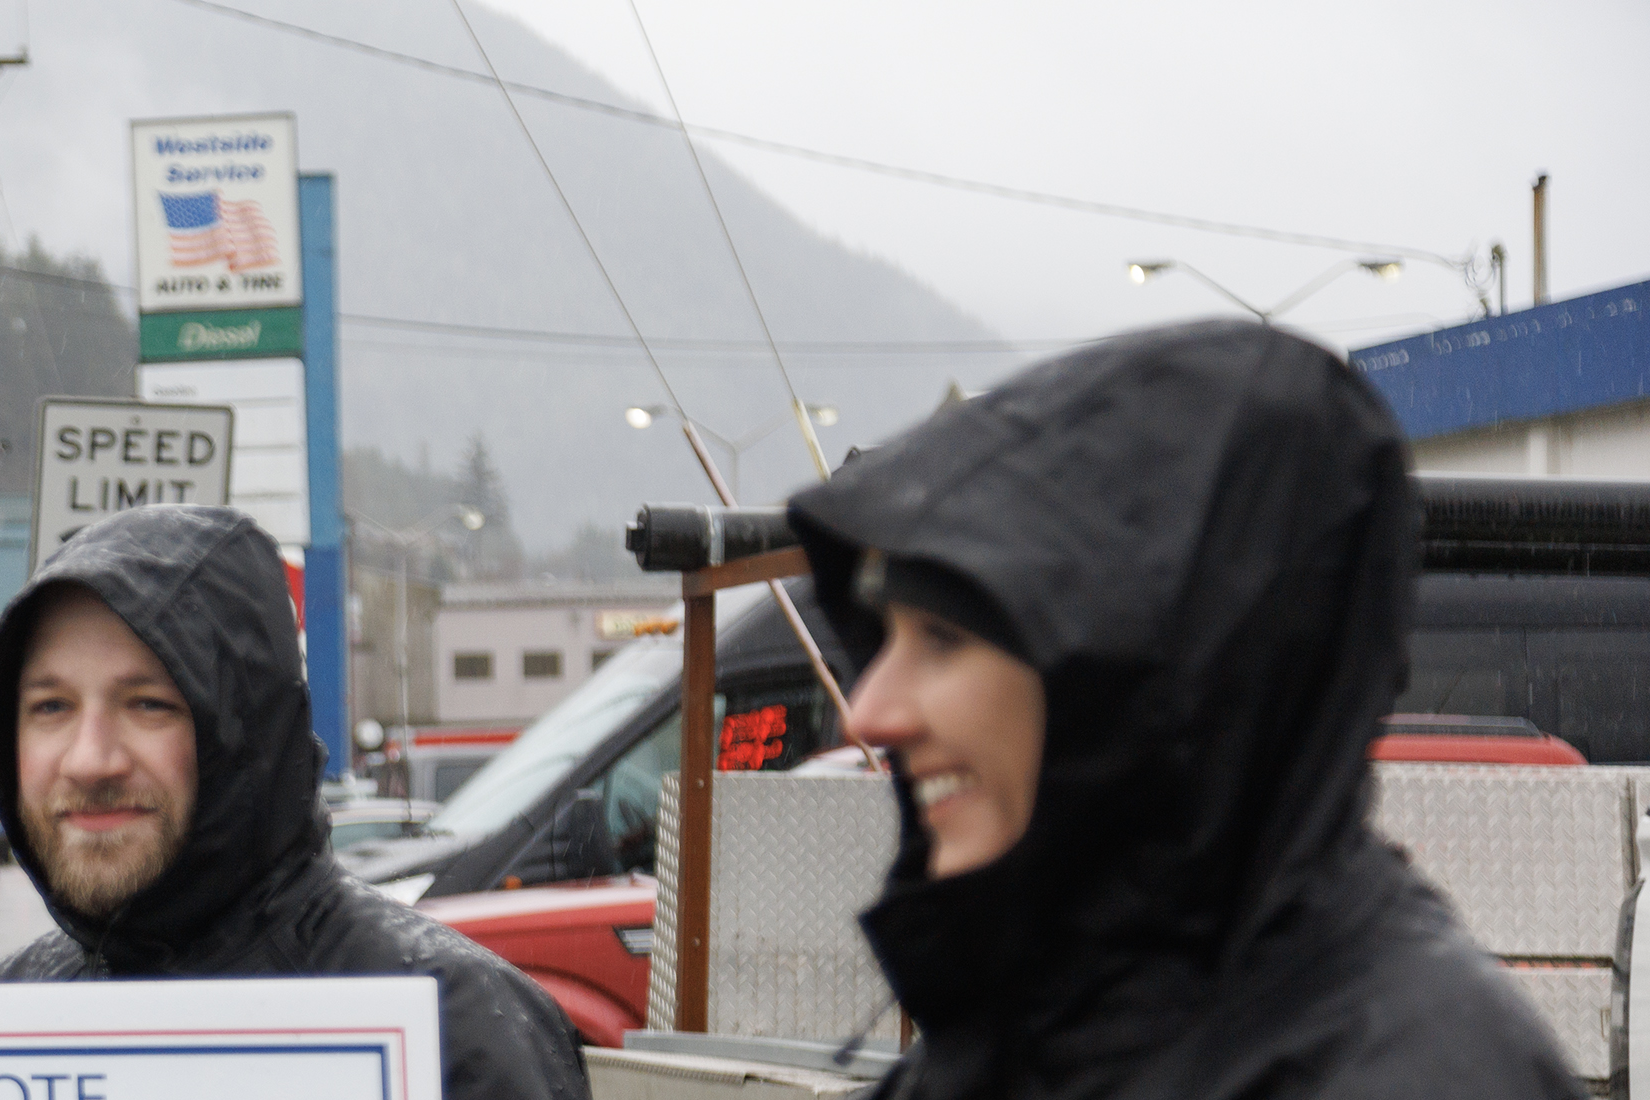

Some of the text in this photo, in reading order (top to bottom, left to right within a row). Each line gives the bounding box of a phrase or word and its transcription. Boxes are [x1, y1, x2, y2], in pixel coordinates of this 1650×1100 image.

[155, 132, 274, 155] Westside
[166, 164, 266, 182] Service
[156, 276, 209, 294] AUTO
[176, 320, 262, 351] Diesel
[56, 425, 216, 465] SPEED
[69, 476, 195, 511] LIMIT
